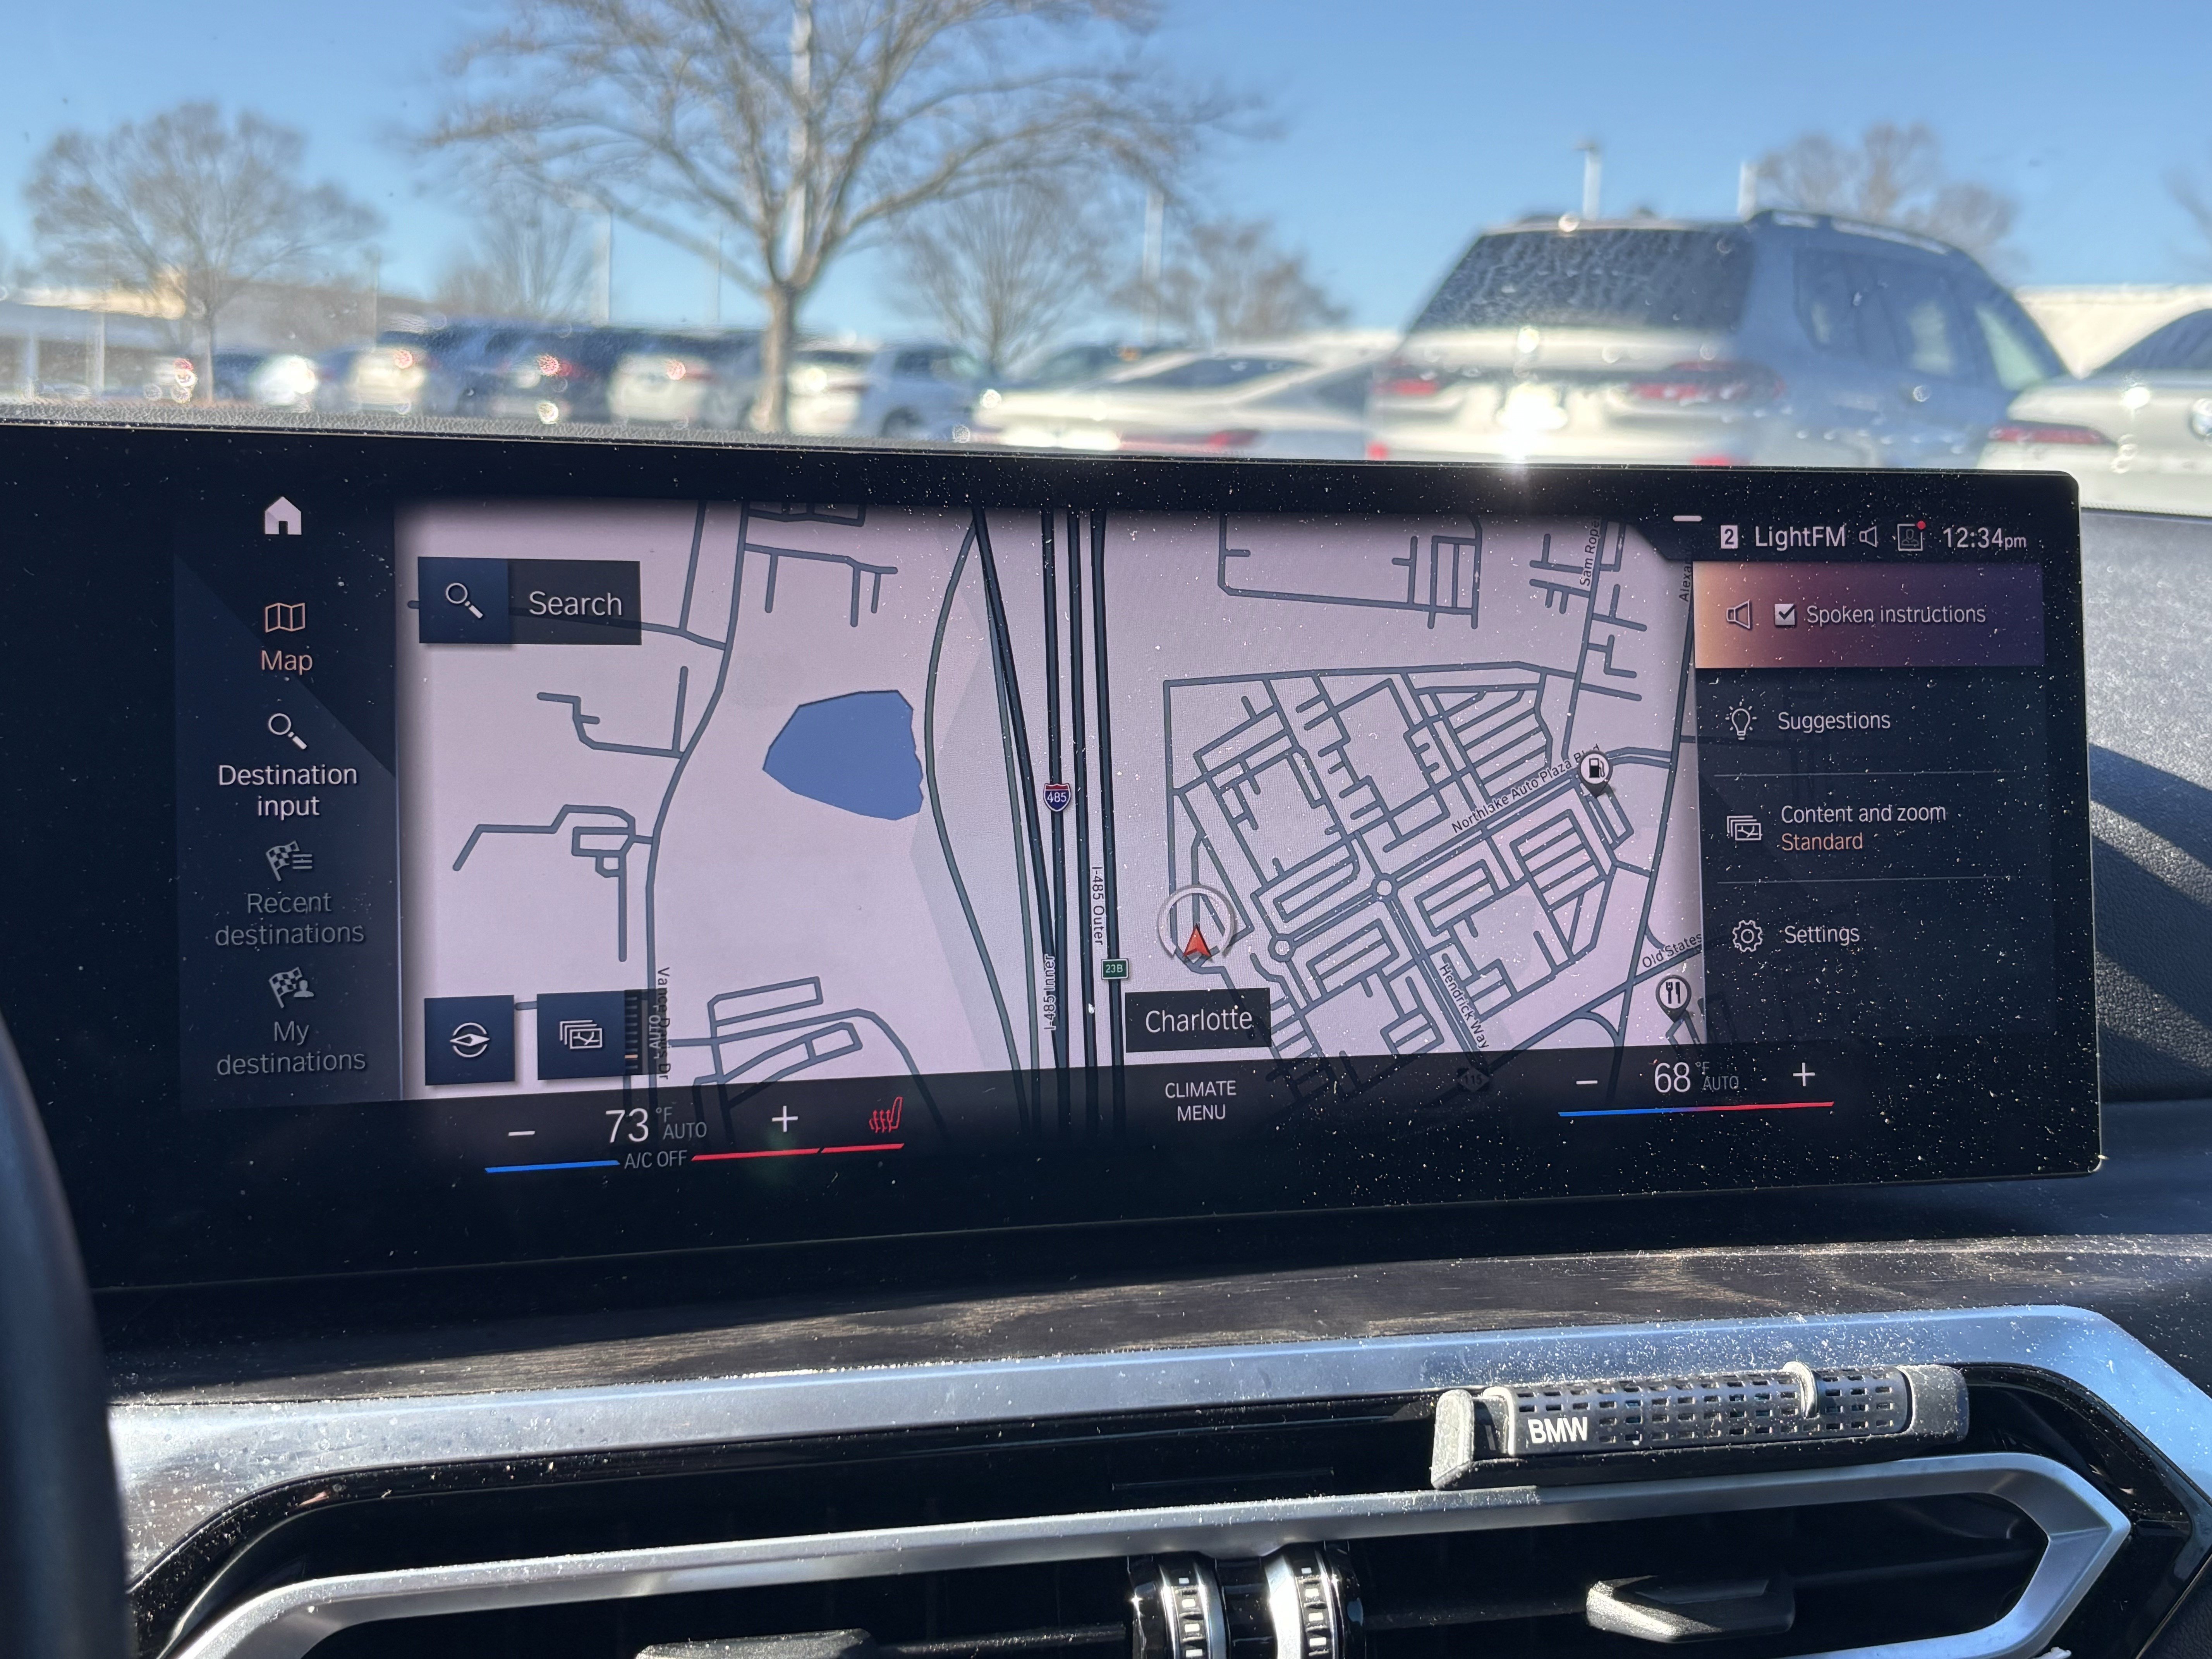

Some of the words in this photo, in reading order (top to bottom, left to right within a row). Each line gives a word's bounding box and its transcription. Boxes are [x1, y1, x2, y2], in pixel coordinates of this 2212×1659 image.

[1725, 529, 1734, 544] 2
[1756, 525, 1845, 551] LightFM
[1943, 527, 2026, 550] 12:34pm
[1580, 558, 1593, 586] Sam
[530, 591, 621, 615] Search
[1807, 606, 1873, 627] Spoken
[1881, 606, 1985, 622] instructions
[262, 651, 312, 675] Map
[1779, 712, 1890, 733] Suggestions
[219, 765, 356, 785] Destination
[1047, 791, 1067, 803] 485
[1451, 796, 1509, 833] Northlake
[1511, 780, 1538, 799] Auto
[1539, 759, 1572, 783] Plaza
[259, 796, 319, 820] input
[1782, 805, 1853, 823] Content
[1859, 804, 1892, 822] and
[1898, 806, 1946, 823] zoom
[1782, 833, 1862, 850] Standard
[1092, 867, 1104, 900] I-485
[248, 893, 331, 914] Recent
[215, 924, 364, 945] destinations
[1093, 905, 1104, 945] Outer
[1785, 926, 1859, 946] Settings
[1106, 964, 1123, 973] 23B
[1642, 950, 1664, 968] Old
[1043, 955, 1055, 990] Inner
[658, 967, 670, 1012] Vance
[1043, 994, 1055, 1030] I-485
[1439, 963, 1474, 1021] Hendrick
[1470, 1020, 1489, 1049] Way
[1146, 1009, 1252, 1032] Charlotte
[275, 1021, 309, 1045] My
[649, 1015, 661, 1049] AUTO
[217, 1053, 365, 1075] destinations
[659, 1063, 671, 1080] Dr
[1654, 1062, 1691, 1093] 68
[1702, 1076, 1739, 1091] AUTO
[1166, 1080, 1236, 1098] CLIMATE
[1178, 1104, 1225, 1121] MENU
[606, 1108, 649, 1143] 73
[663, 1122, 707, 1140] AUTO
[624, 1152, 652, 1169] A/C
[657, 1150, 687, 1167] OFF
[1528, 1417, 1587, 1443] BMW
